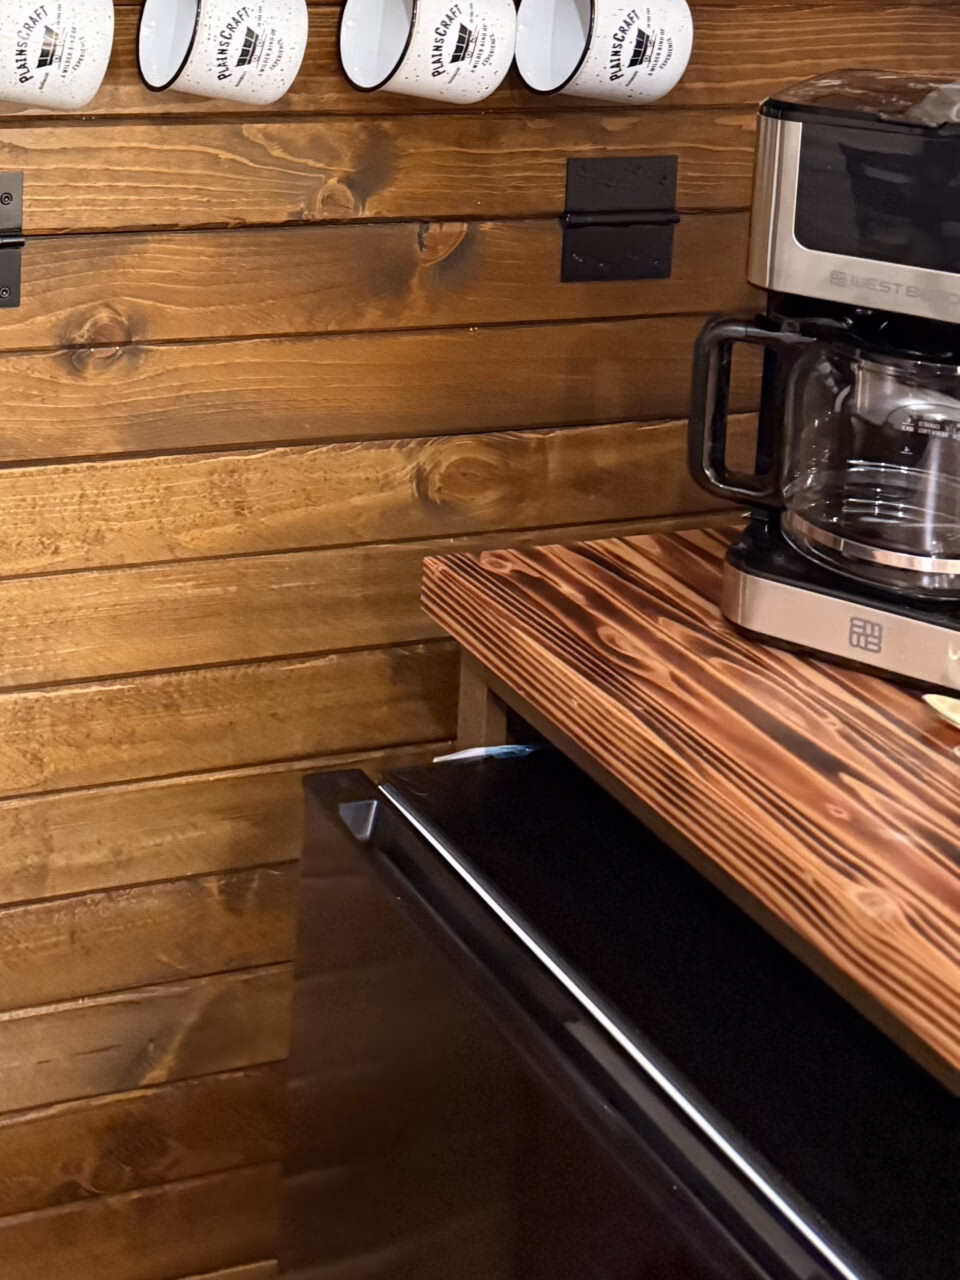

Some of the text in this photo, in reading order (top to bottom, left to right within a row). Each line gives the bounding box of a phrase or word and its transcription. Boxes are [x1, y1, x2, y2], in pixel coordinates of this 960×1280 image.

[15, 5, 48, 84] PLAINSCRAFT
[216, 6, 250, 81] PLAINSCRAFT
[432, 4, 462, 77] PLAINSCRAFT
[609, 9, 640, 81] PLAINSCRAFT
[849, 274, 905, 295] WEST
